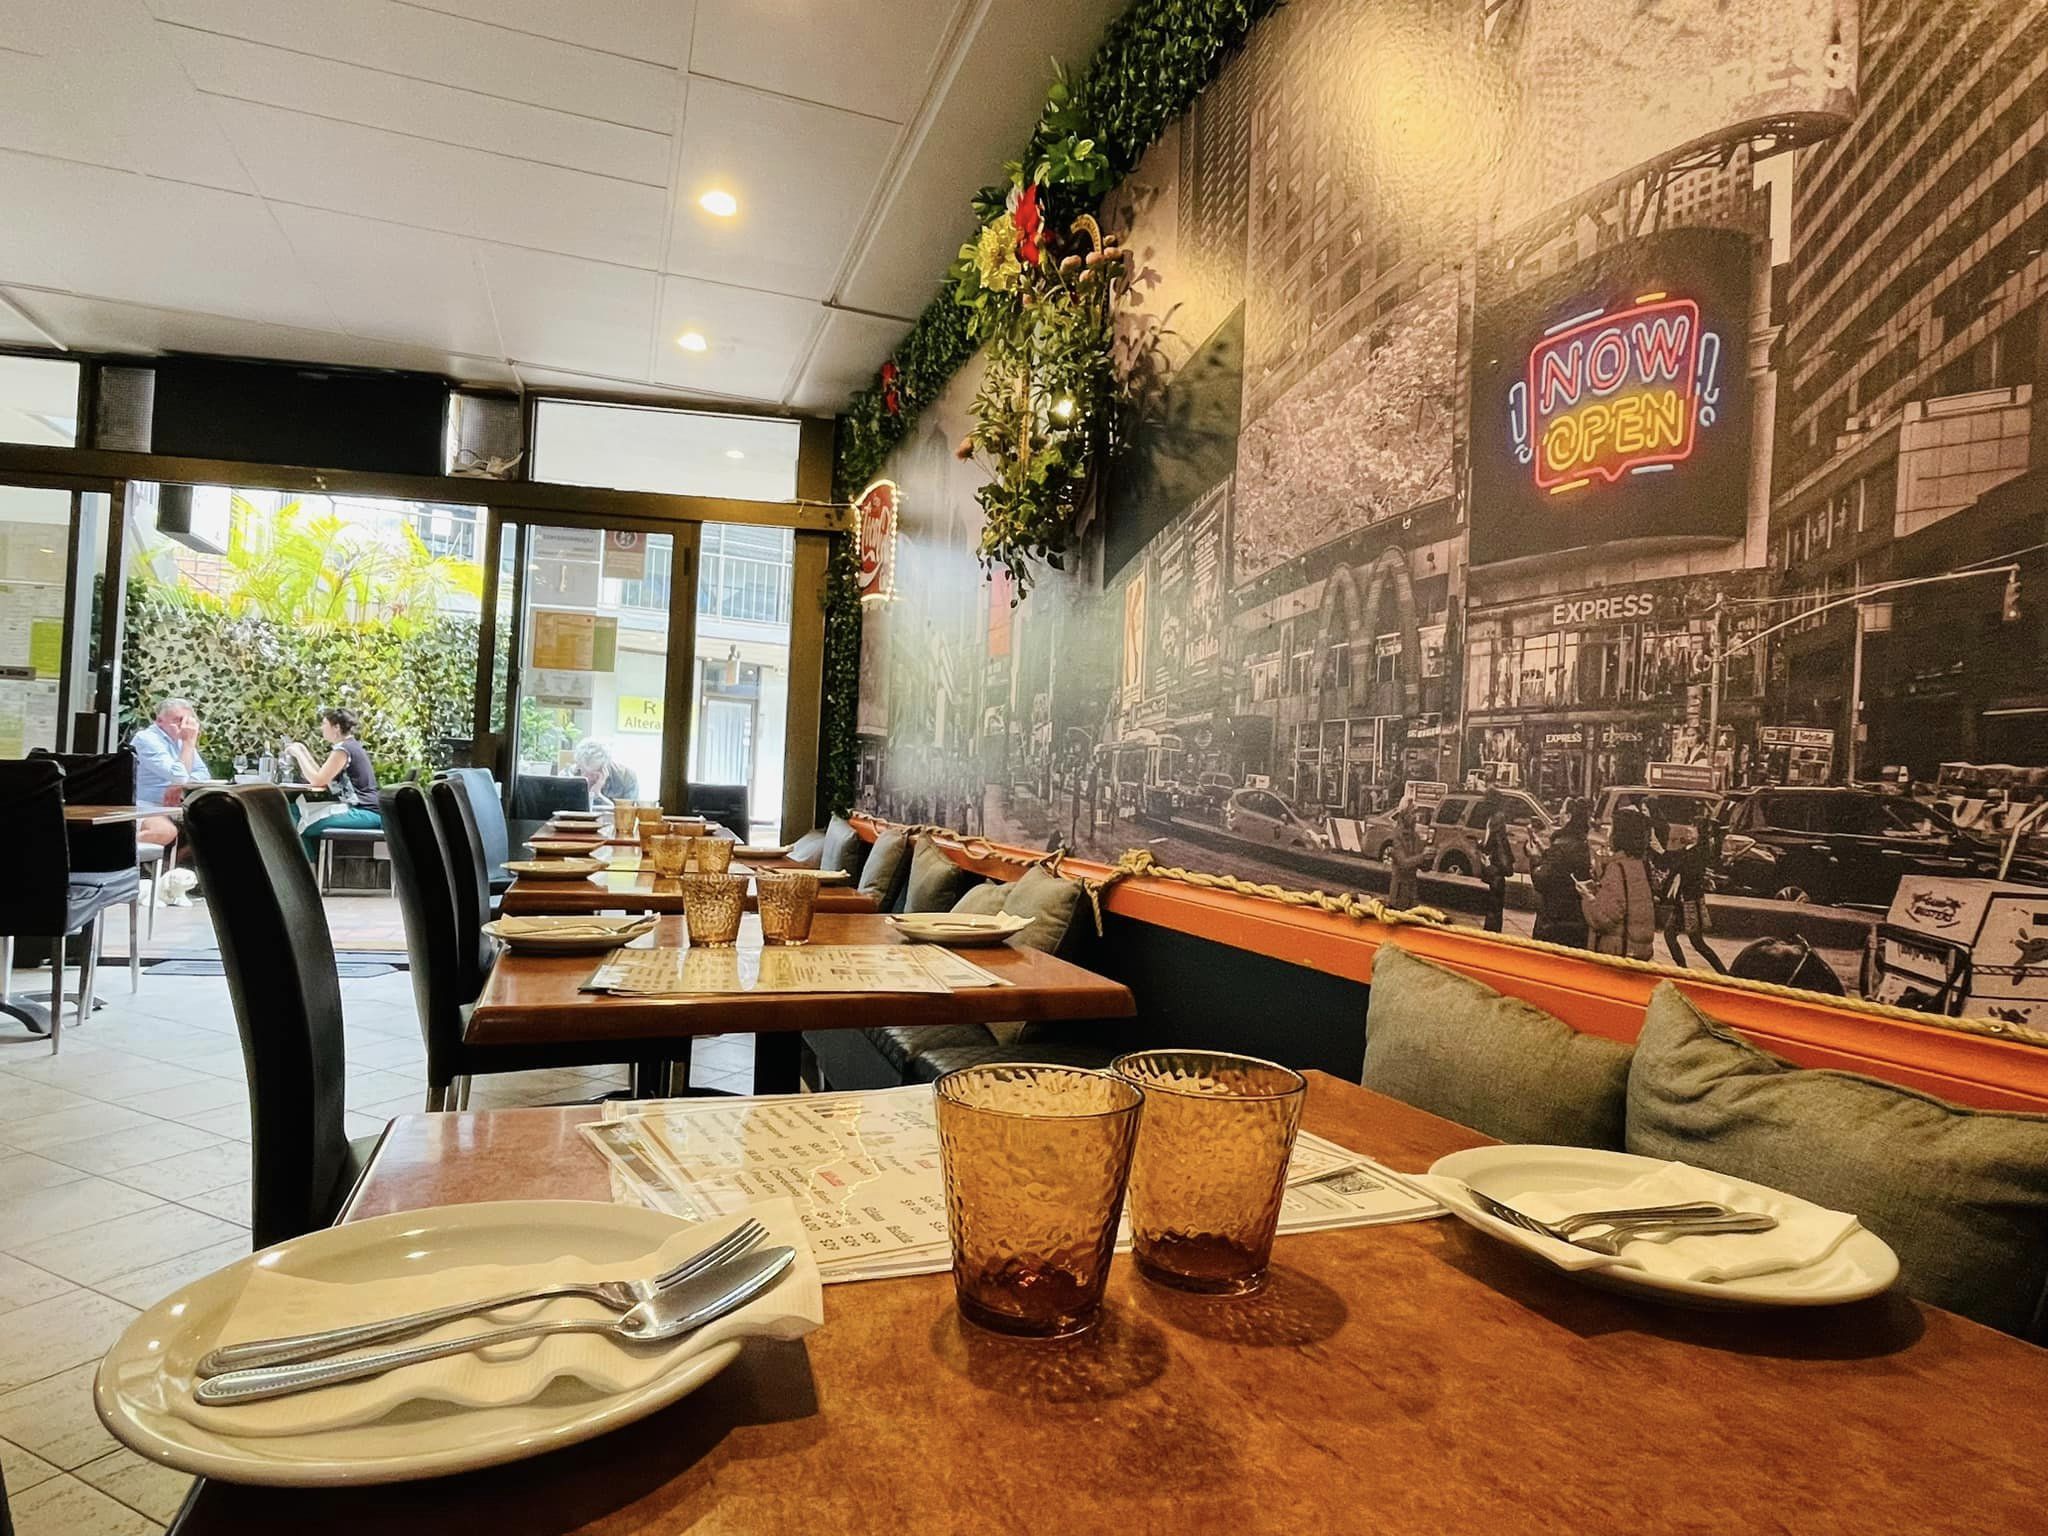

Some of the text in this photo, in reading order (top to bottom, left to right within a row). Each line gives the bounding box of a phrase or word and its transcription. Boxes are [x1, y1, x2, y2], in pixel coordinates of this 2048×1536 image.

[1540, 315, 1690, 414] NOW
[1542, 390, 1685, 471] OPEN
[1553, 593, 1654, 625] EXPRESS
[643, 700, 656, 715] R
[1545, 732, 1582, 743] EXPRESS
